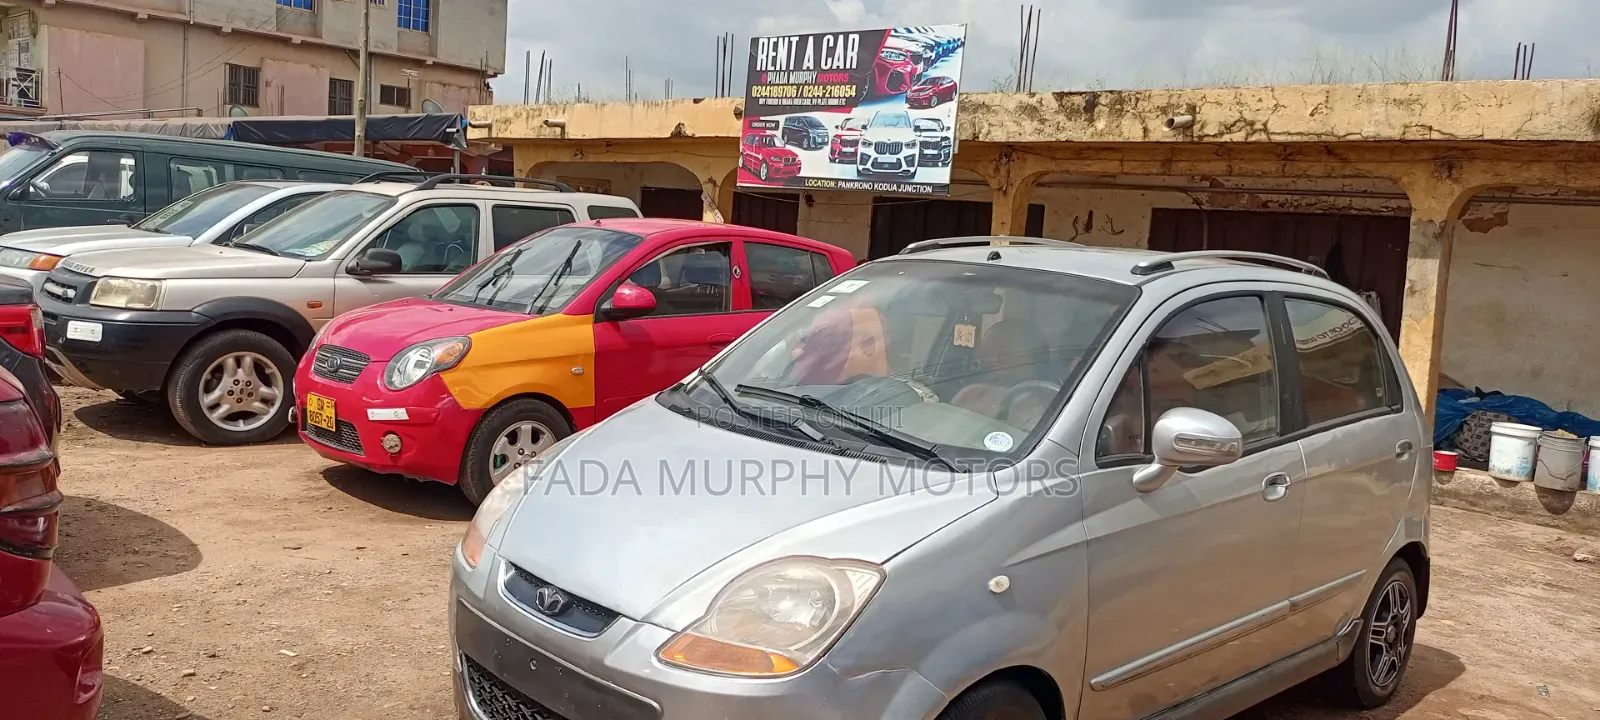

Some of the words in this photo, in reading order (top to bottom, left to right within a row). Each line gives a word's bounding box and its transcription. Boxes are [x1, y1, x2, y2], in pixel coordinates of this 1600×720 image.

[756, 37, 799, 71] RENT
[802, 36, 814, 70] A
[820, 34, 859, 70] CAR
[789, 71, 817, 84] MURPHY
[817, 73, 849, 83] MOTORS
[751, 85, 797, 98] 0244189706
[803, 85, 857, 98] 0244-216054
[804, 179, 836, 188] LOCATION:
[837, 182, 873, 191] PANKRONO
[873, 184, 898, 192] KODUA
[898, 186, 933, 194] JUNCTION
